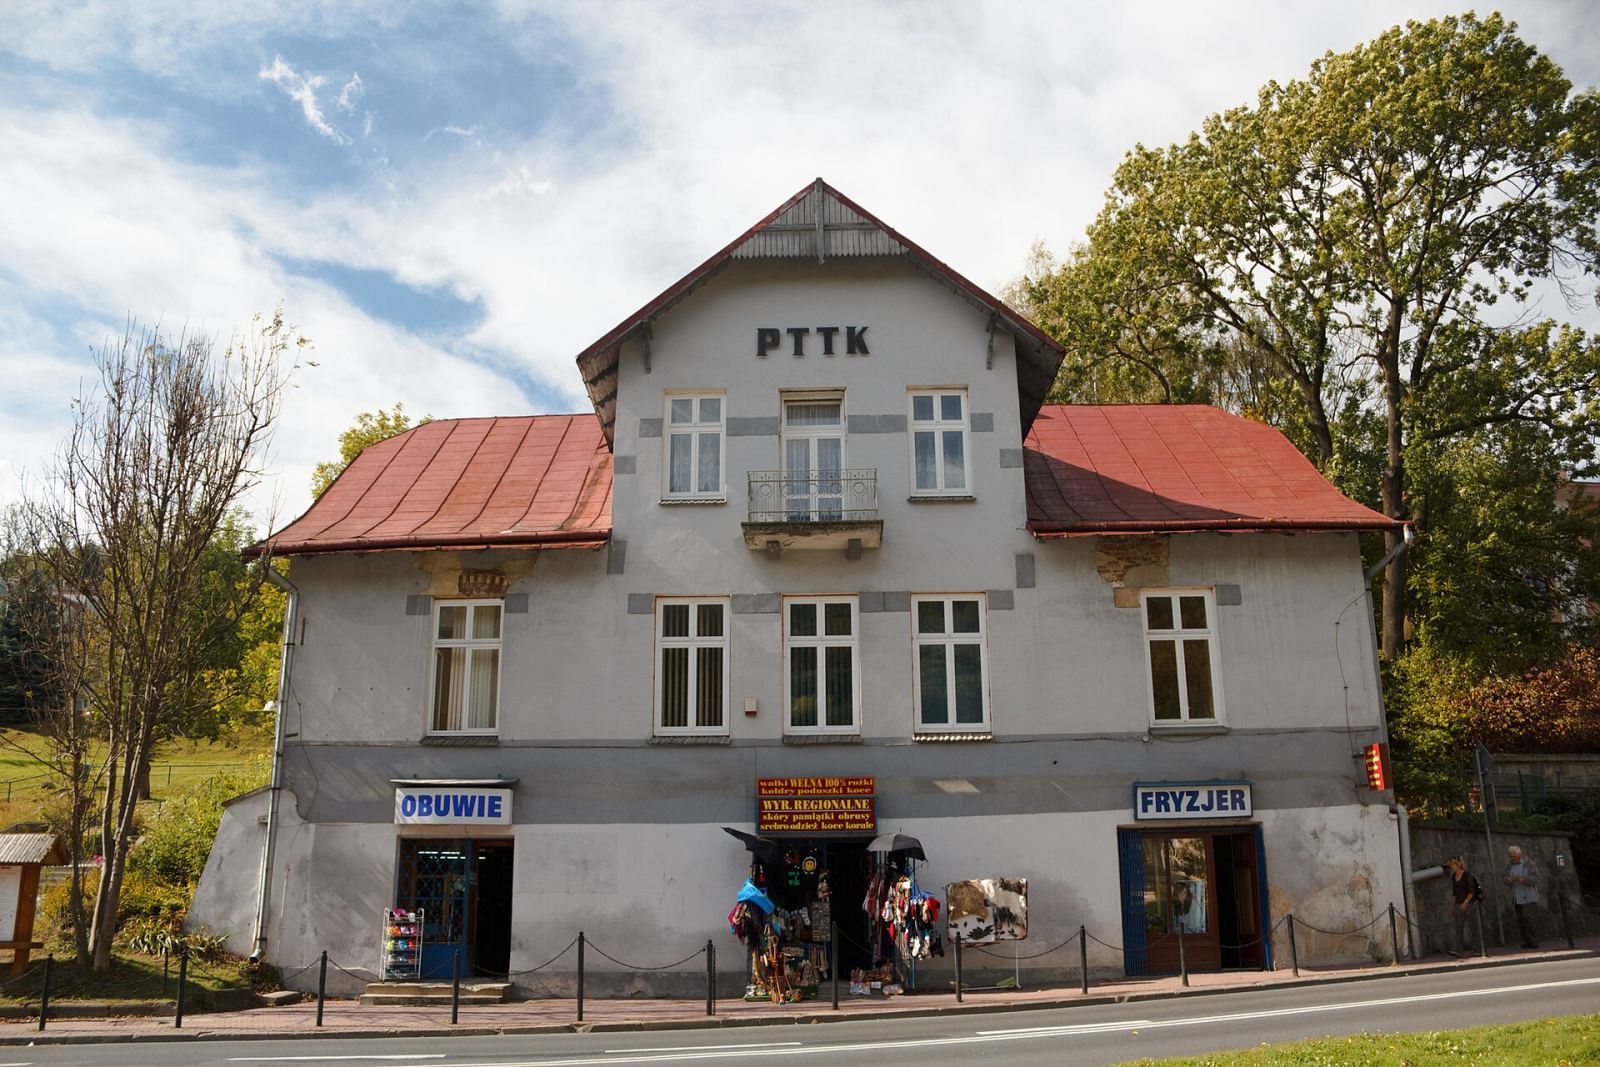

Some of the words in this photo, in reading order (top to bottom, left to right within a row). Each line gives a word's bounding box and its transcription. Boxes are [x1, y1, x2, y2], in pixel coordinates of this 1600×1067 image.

[756, 326, 870, 356] PTTK
[797, 787, 843, 796] poduszki
[401, 795, 502, 818] OBUWIE
[763, 799, 793, 810] WYR.
[794, 799, 870, 810] REGIONALNE
[1140, 789, 1246, 813] FRYZJER
[838, 812, 871, 821] obrusy
[821, 822, 844, 830] koce
